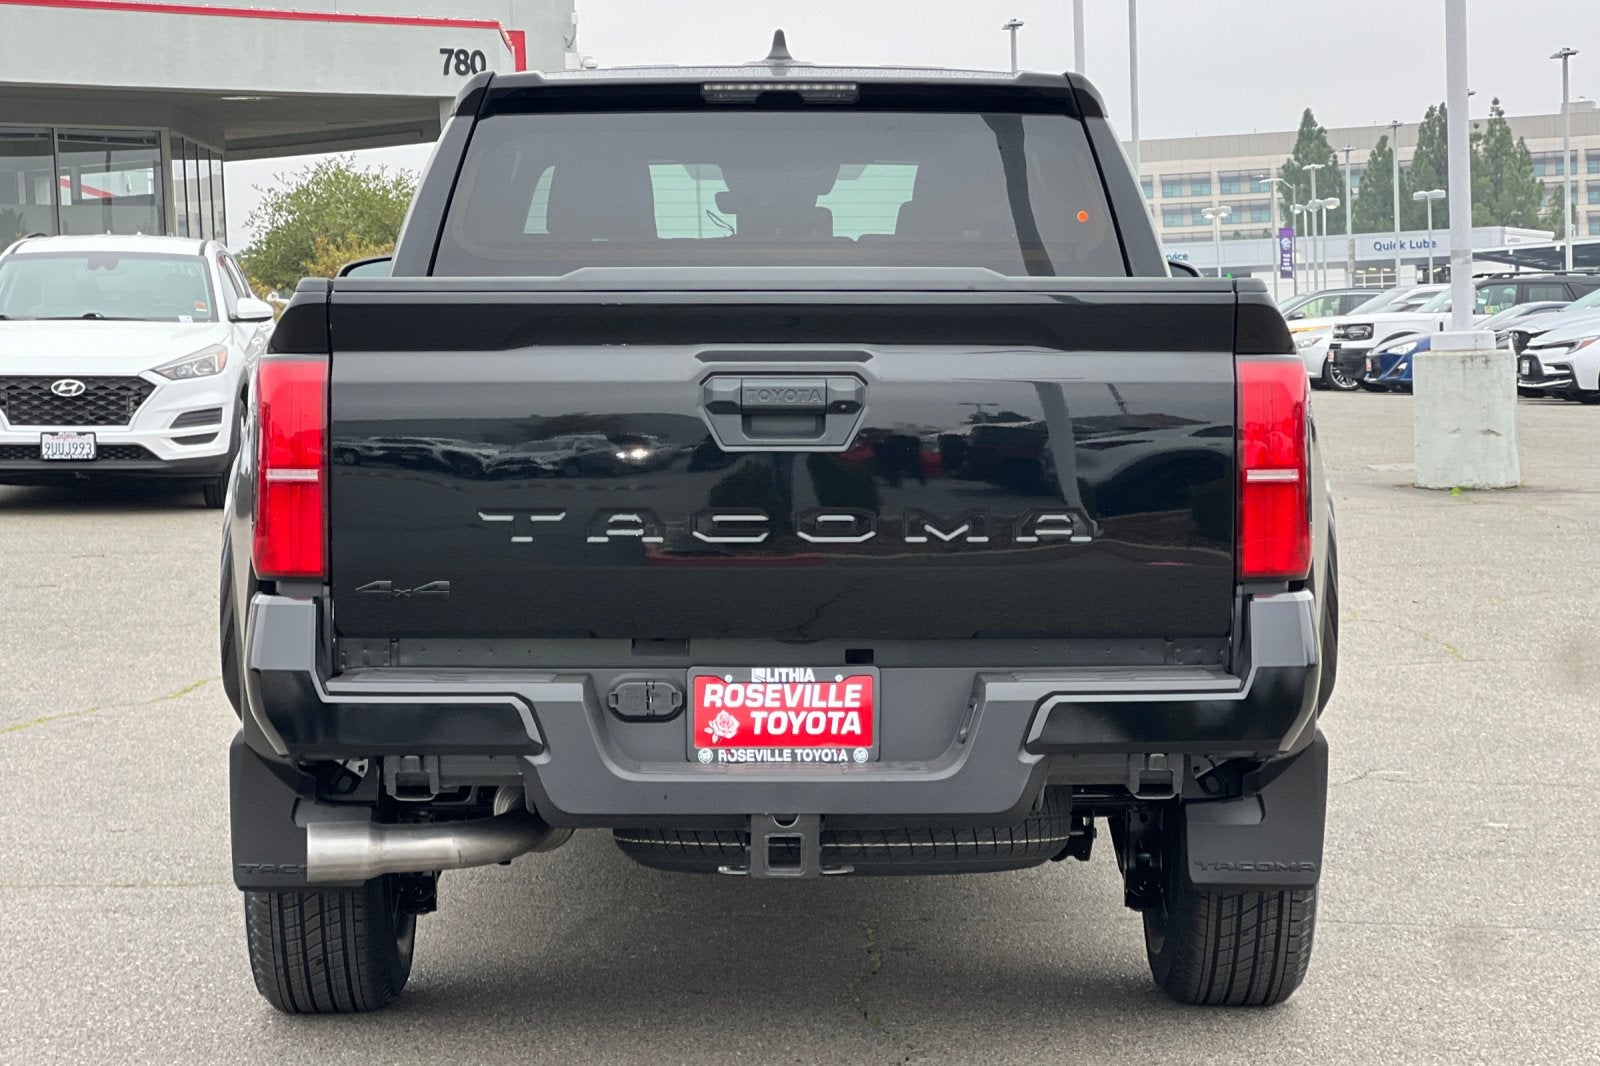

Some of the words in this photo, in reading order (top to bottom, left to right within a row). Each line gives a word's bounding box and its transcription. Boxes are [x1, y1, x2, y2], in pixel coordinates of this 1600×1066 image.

[440, 48, 486, 76] 780
[1409, 239, 1437, 249] Lube
[1166, 252, 1189, 261] rvice
[746, 388, 822, 403] TOYOTA
[477, 507, 1093, 543] TACOMA
[355, 580, 450, 597] 4x4
[765, 668, 815, 682] LITHIA
[703, 683, 863, 708] ROSEVILLE
[750, 711, 862, 735] TOYOTA
[718, 749, 792, 762] ROSEVILLE
[794, 749, 849, 762] TOYOTA
[238, 863, 307, 874] TAC
[1194, 861, 1316, 872] TACOMA
